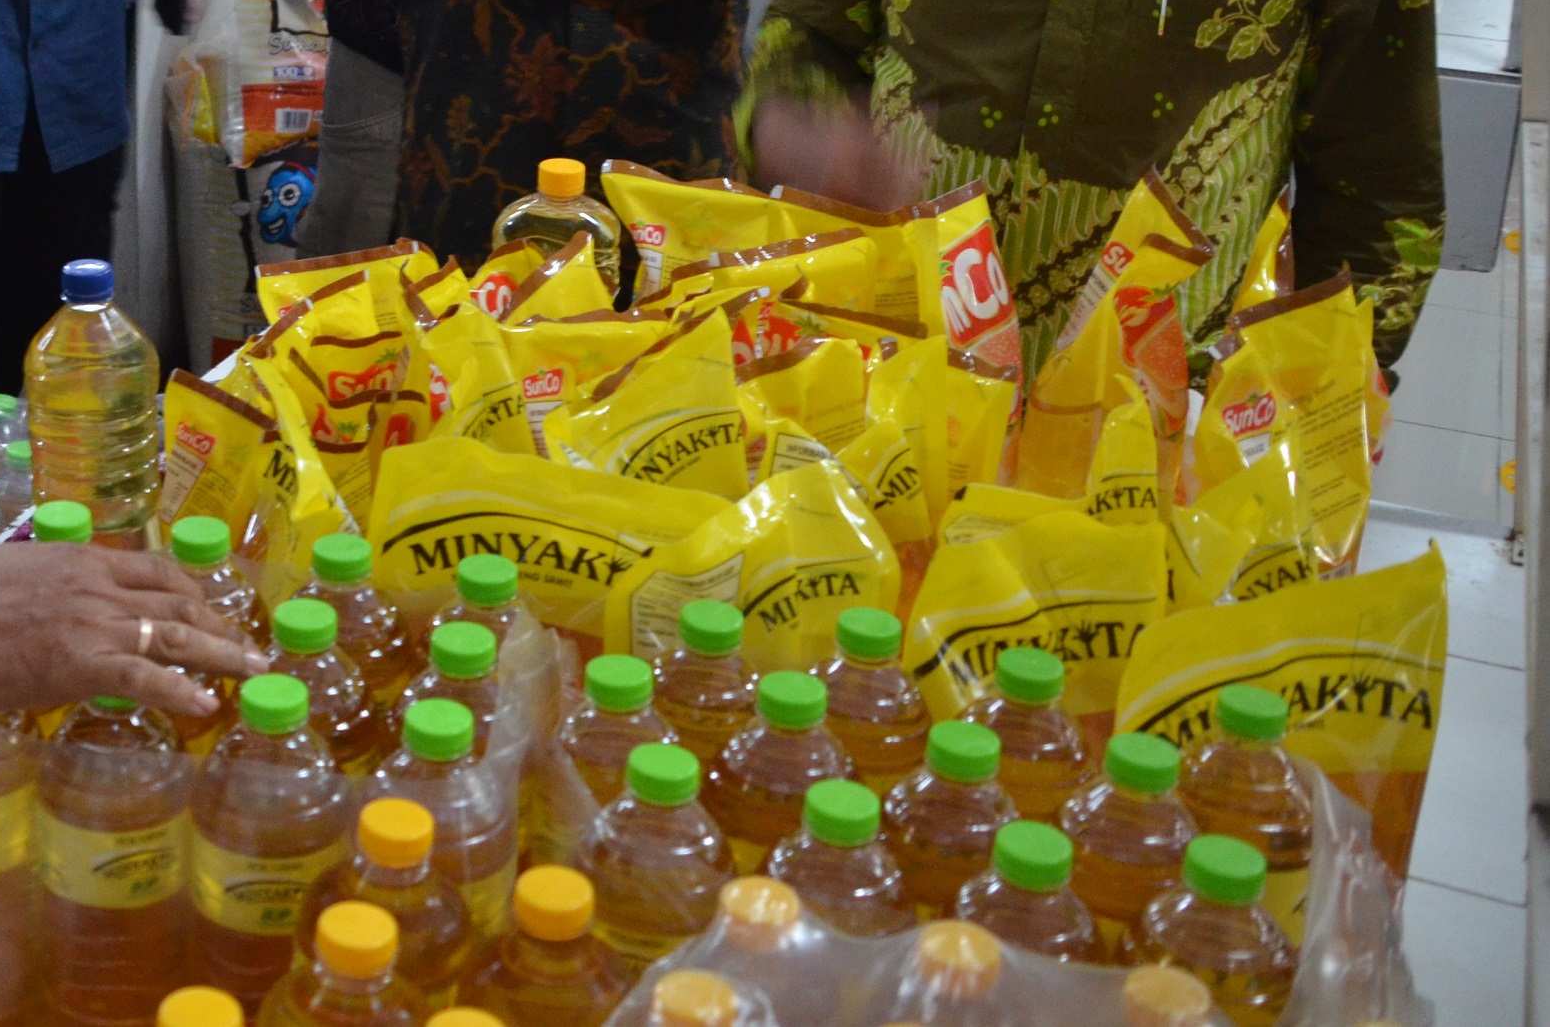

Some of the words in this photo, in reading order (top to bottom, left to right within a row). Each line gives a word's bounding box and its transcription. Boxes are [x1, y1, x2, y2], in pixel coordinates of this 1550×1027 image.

[524, 372, 561, 395] SunCo
[1223, 396, 1275, 434] SunCo
[1087, 486, 1157, 515] KITA
